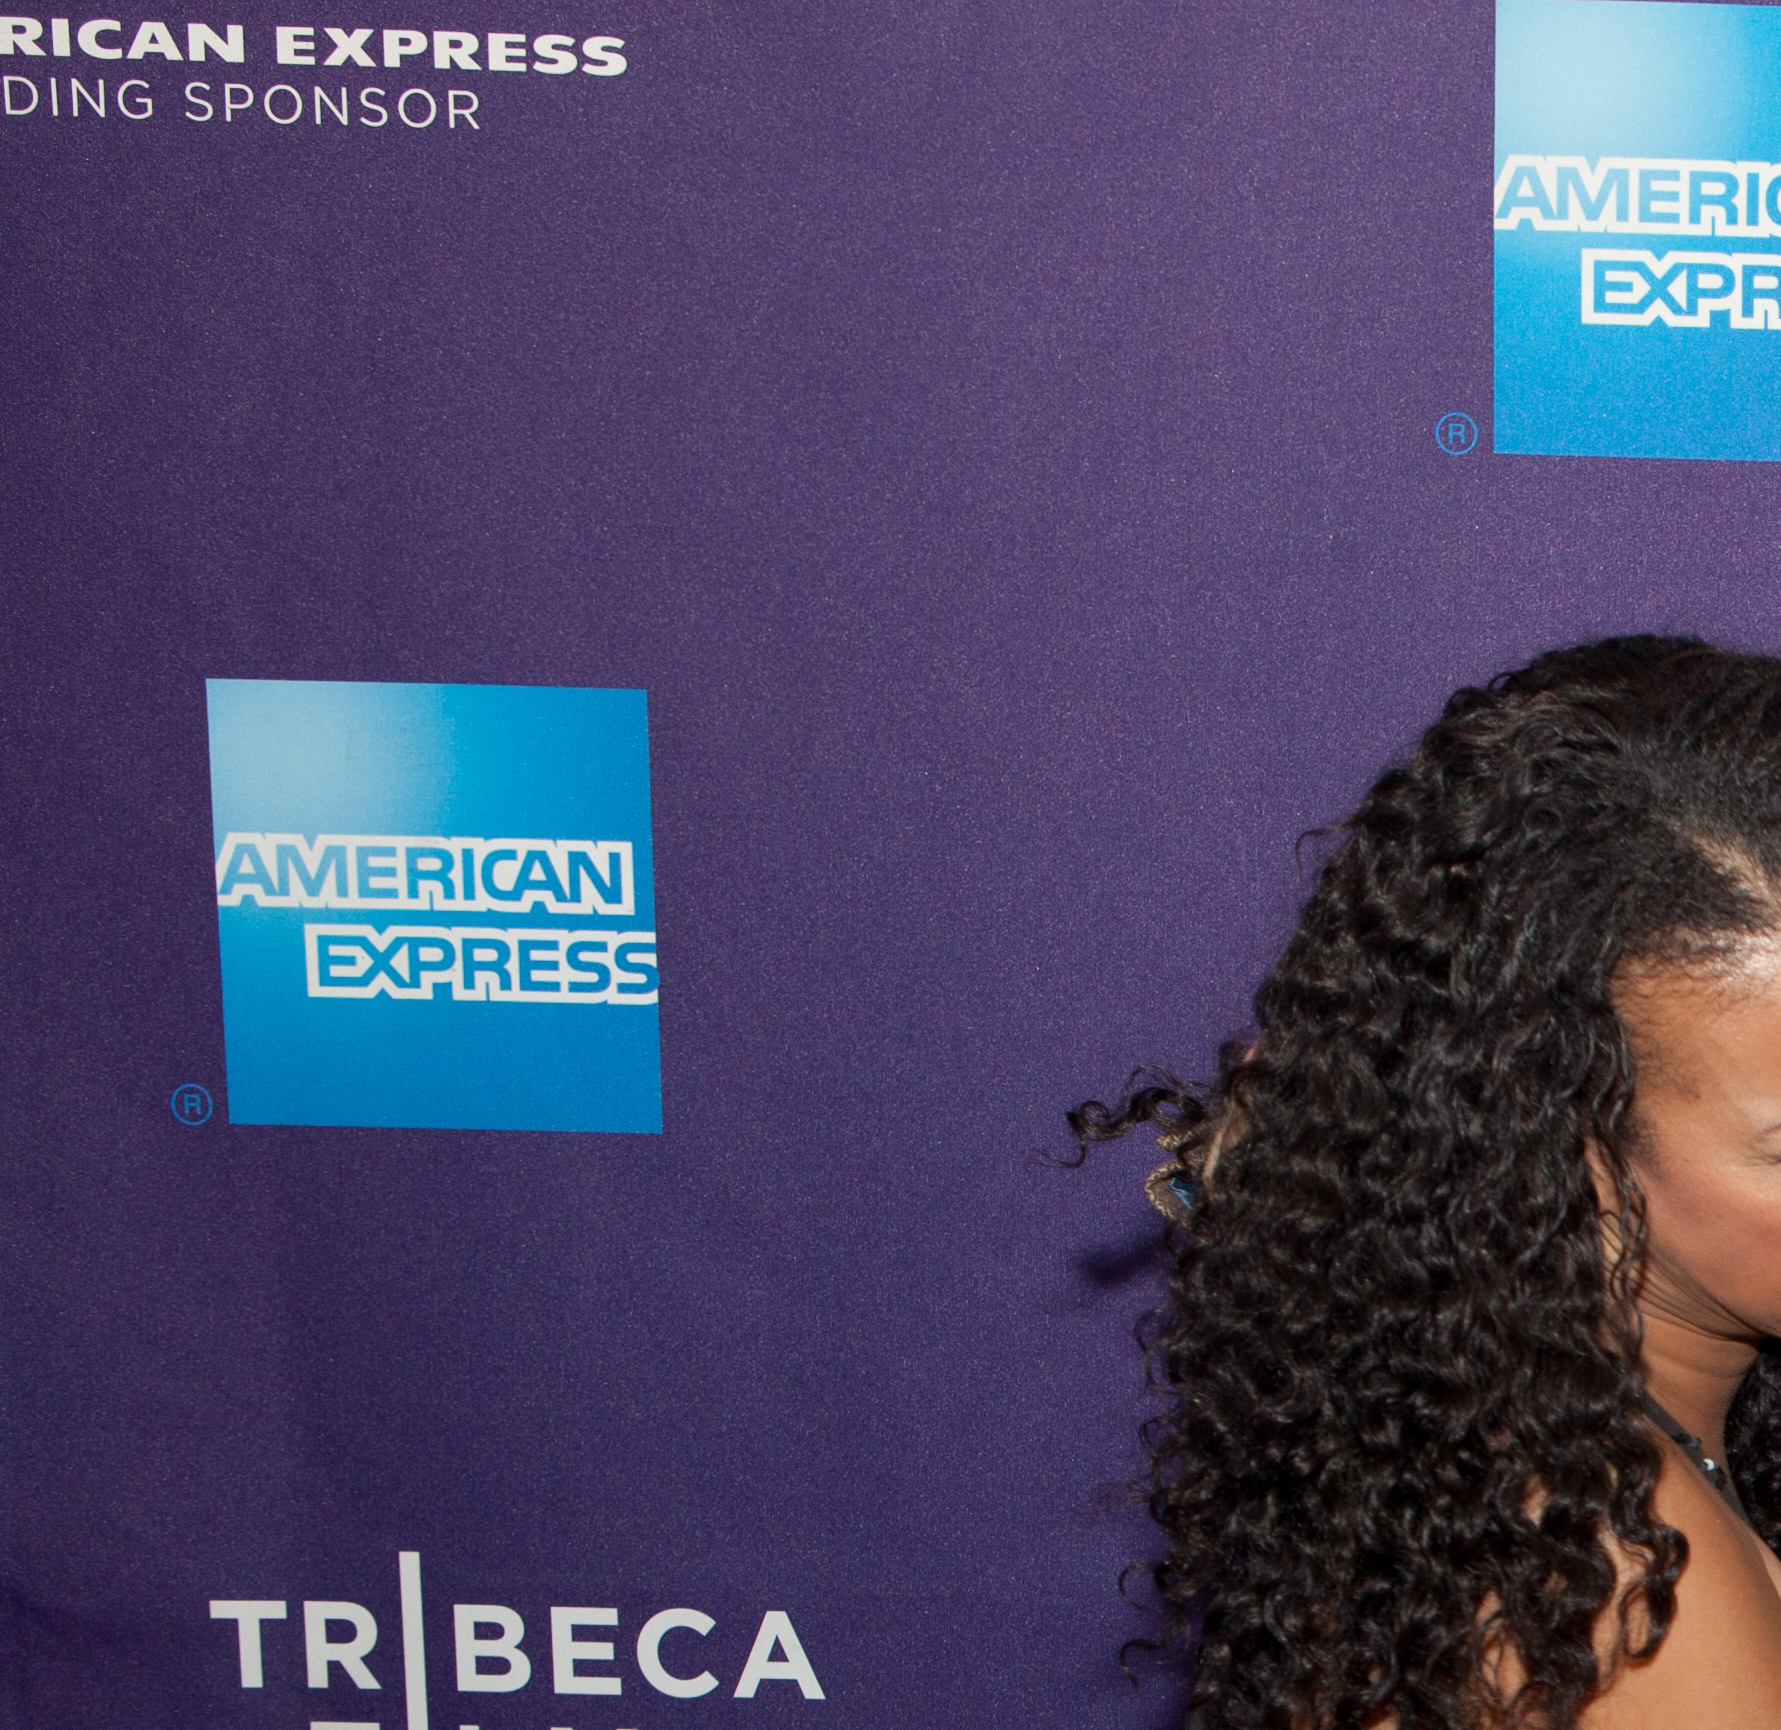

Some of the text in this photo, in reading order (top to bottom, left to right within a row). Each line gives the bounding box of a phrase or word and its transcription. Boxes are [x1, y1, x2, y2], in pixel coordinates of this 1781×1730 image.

[0, 17, 627, 76] RICAN EXPRESS
[4, 76, 479, 129] DING SPONSOR
[215, 832, 635, 914] AMERICAN
[304, 924, 660, 1005] EXPRESS
